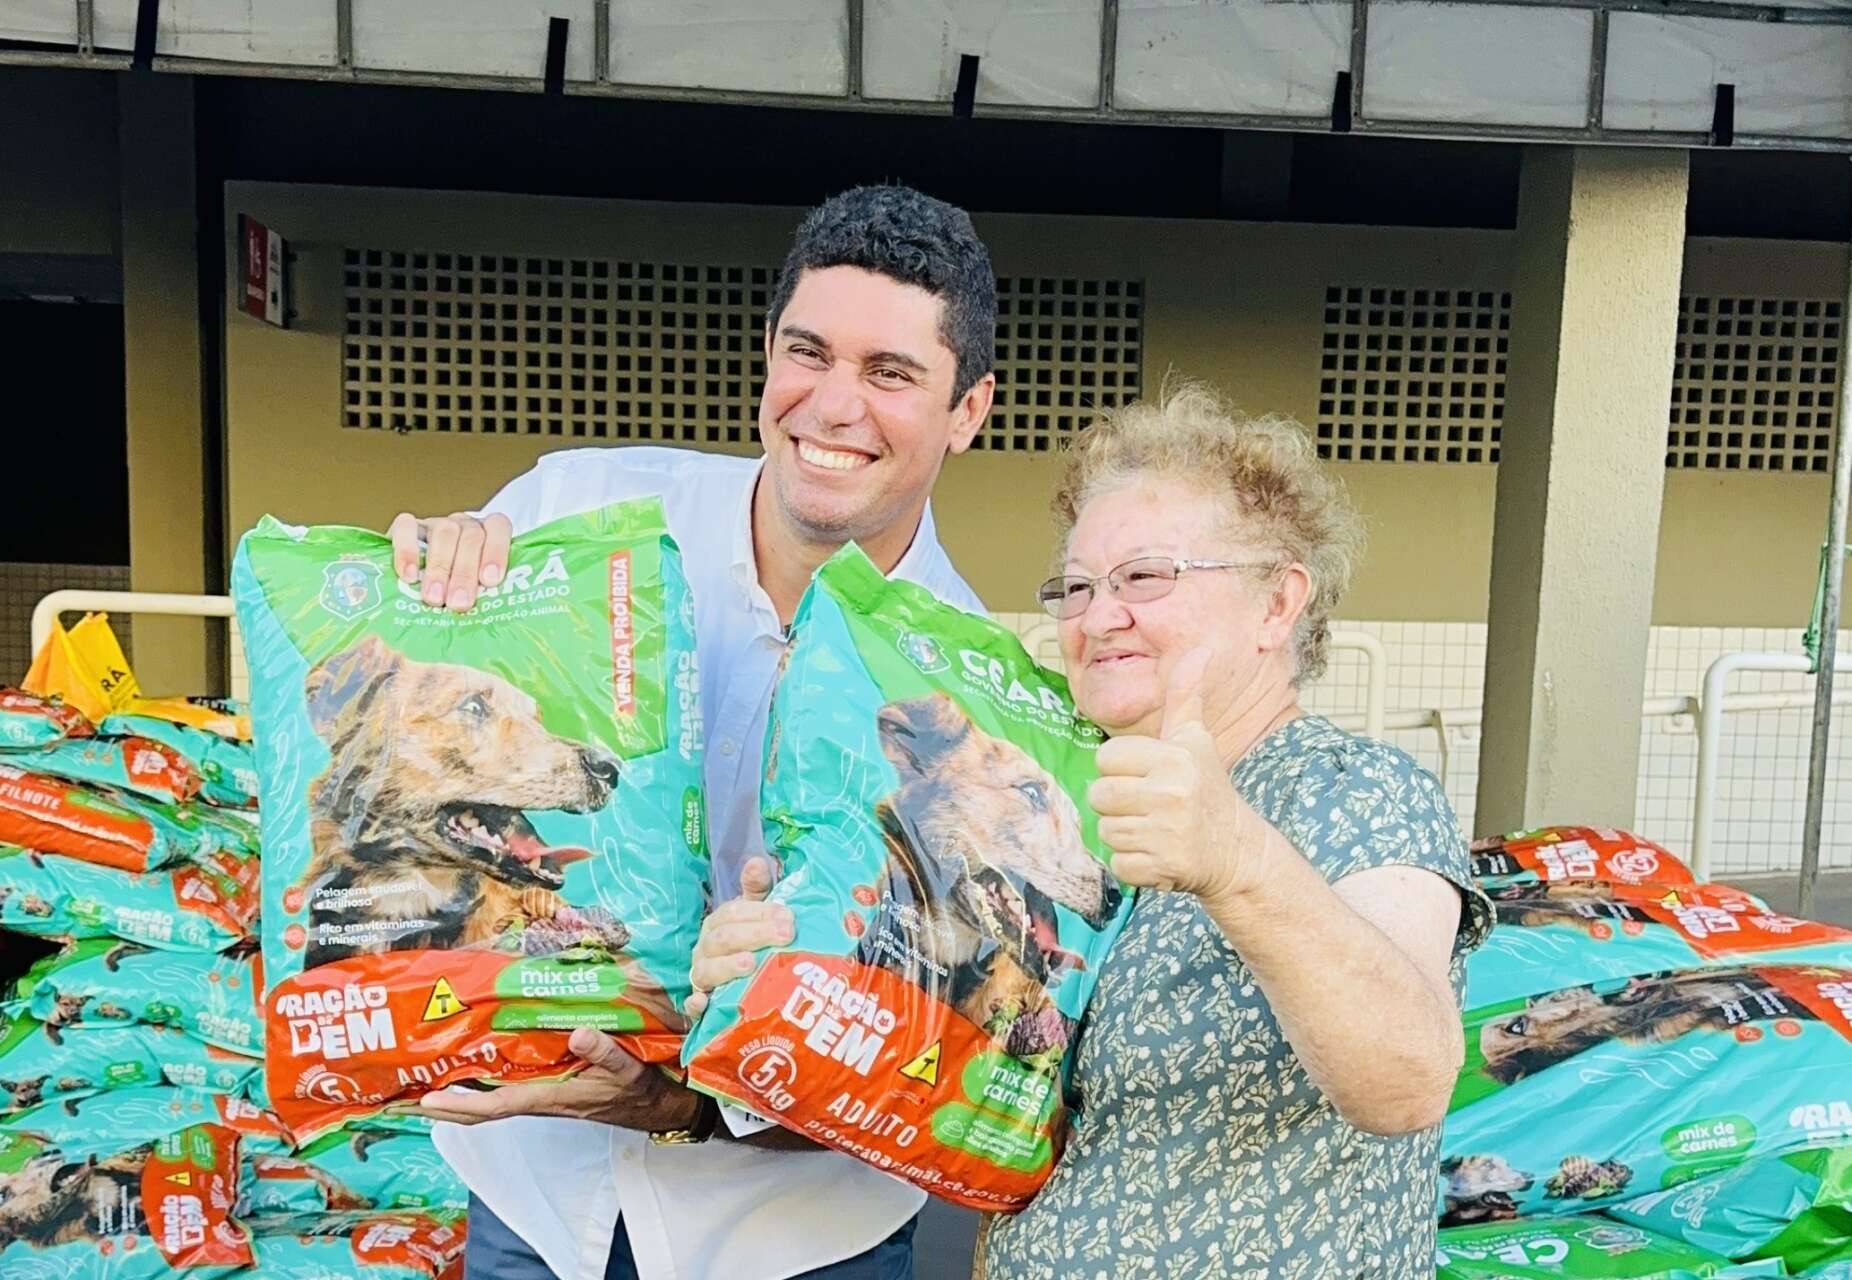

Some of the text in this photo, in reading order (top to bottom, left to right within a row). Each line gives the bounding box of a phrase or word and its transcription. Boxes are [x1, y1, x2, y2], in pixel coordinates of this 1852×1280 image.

[481, 599, 504, 613] DO
[508, 584, 571, 606] ESTADO
[612, 557, 632, 705] VENDA PROIBIDA
[958, 649, 1078, 718] CEAR
[1026, 706, 1047, 721] DO
[1, 783, 62, 810] FILHOTE
[315, 886, 367, 898] Pelagem
[320, 917, 425, 934] Rico em vitaminas
[328, 932, 380, 945] minerais
[520, 965, 600, 985] mix de
[276, 984, 388, 1018] RAÇÃO
[435, 994, 451, 1014] T
[523, 982, 600, 998] carnes
[792, 961, 897, 1035] RAÇÃO
[288, 1008, 398, 1060] BEM
[780, 985, 886, 1077] BEM
[396, 1041, 497, 1087] ADULTO
[990, 1065, 1049, 1100] mix de
[982, 1081, 1041, 1116] carnes
[1678, 1120, 1736, 1142] mix de
[1679, 1134, 1739, 1154] carnes
